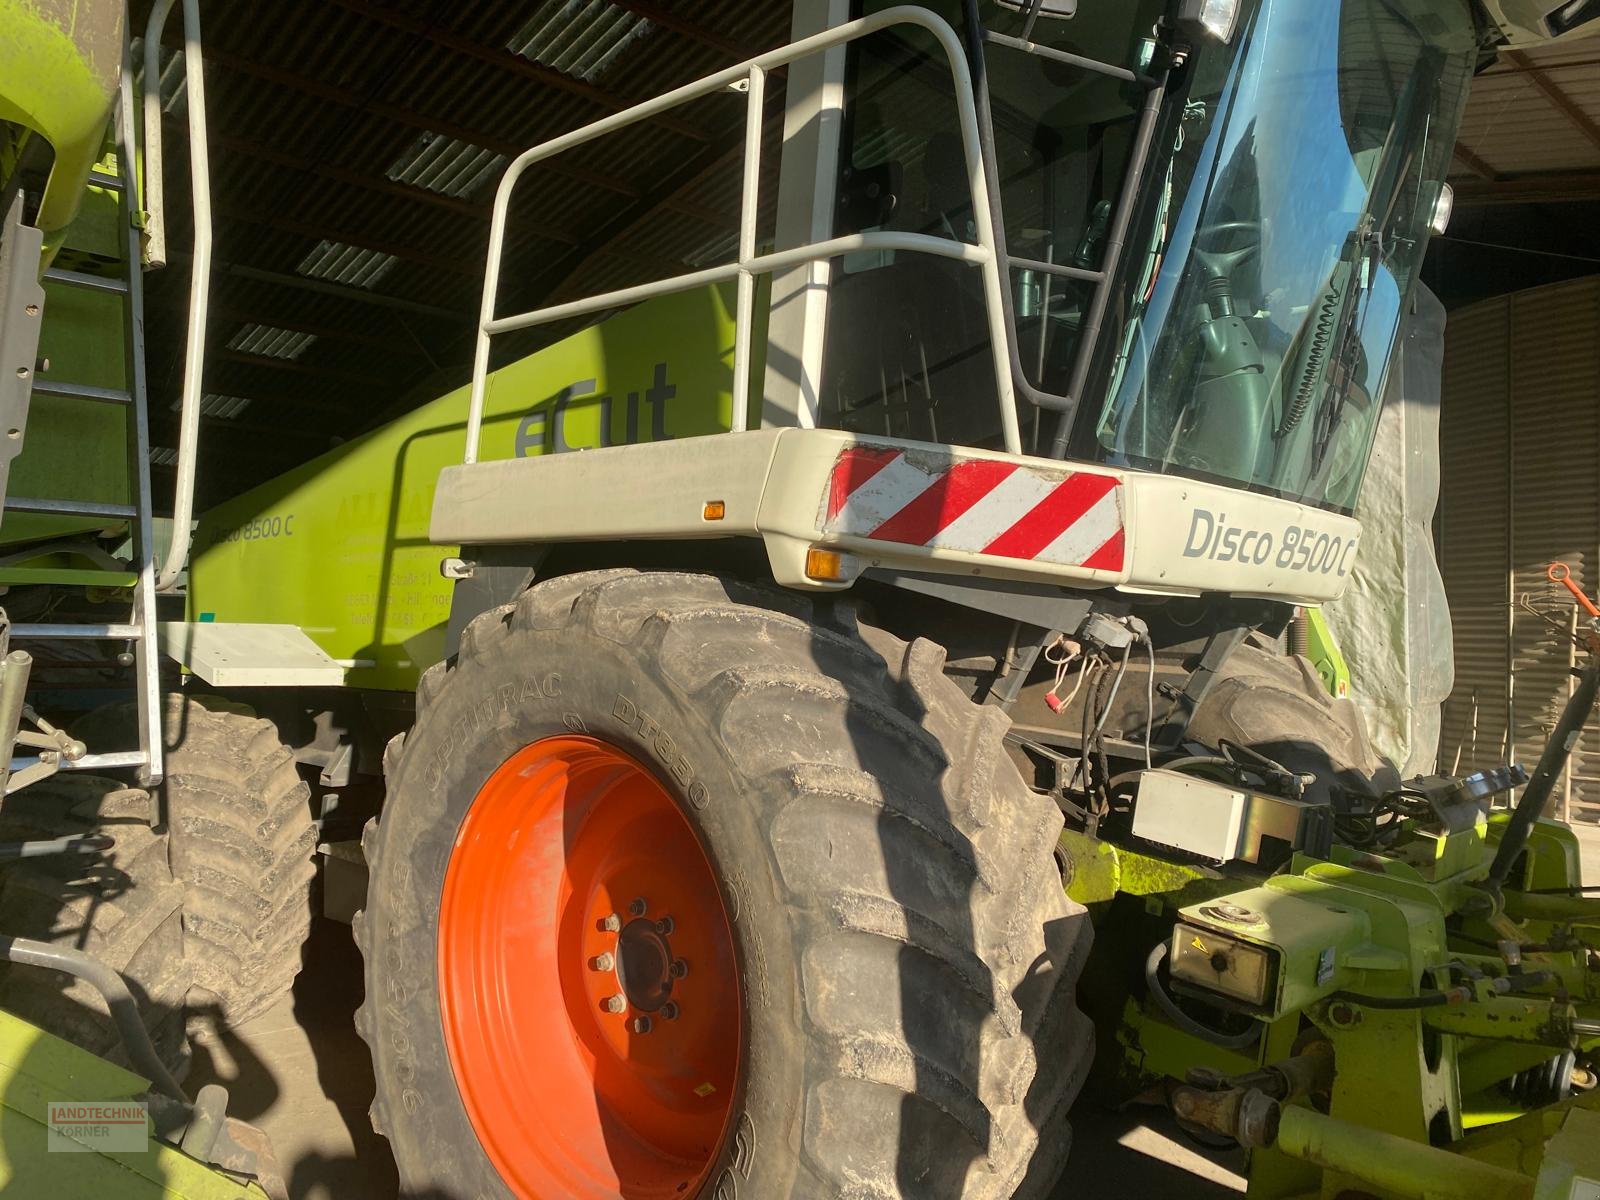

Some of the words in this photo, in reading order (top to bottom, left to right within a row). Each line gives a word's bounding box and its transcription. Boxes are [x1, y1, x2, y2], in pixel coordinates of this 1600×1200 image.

[242, 516, 282, 541] 8500
[284, 514, 295, 536] C
[1182, 508, 1274, 566] Disco
[1275, 525, 1342, 575] 8500
[1337, 539, 1356, 577] C
[423, 672, 562, 792] OPTITRAC
[611, 692, 710, 811] DT830
